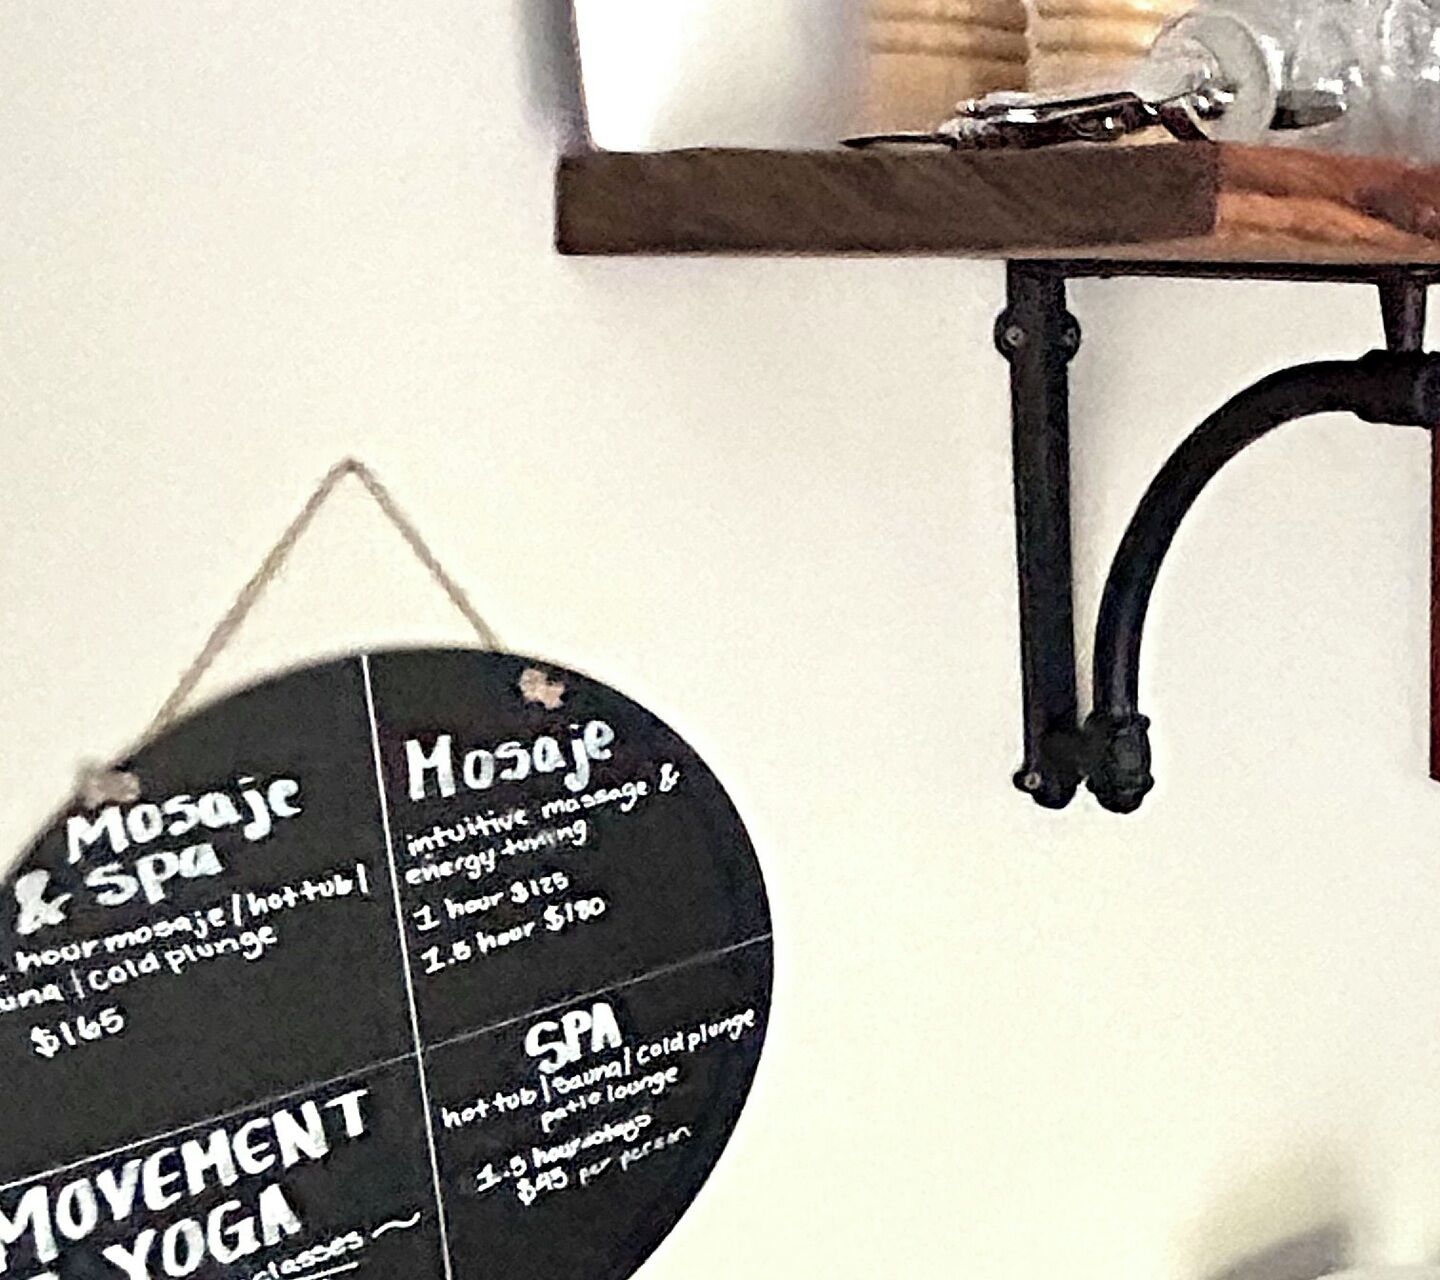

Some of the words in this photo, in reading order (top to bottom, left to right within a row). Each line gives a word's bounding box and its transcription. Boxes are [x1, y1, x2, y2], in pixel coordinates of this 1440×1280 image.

[405, 720, 615, 801] Mosaje
[67, 776, 302, 864] Mosaje
[408, 809, 529, 857] intuitive
[542, 781, 648, 819] massage
[658, 763, 680, 792] &
[404, 848, 497, 885] energy
[15, 869, 73, 935] &
[413, 904, 440, 931] 1
[444, 891, 504, 920] hour
[510, 871, 569, 904] $125
[15, 937, 98, 973] hour
[164, 925, 278, 975] plunge
[476, 921, 536, 955] hour
[30, 1006, 125, 1058] $165
[524, 1002, 623, 1074] SPA
[688, 1007, 756, 1054] plunge
[608, 1066, 679, 1103] lounge
[0, 1088, 369, 1274] MOVEMENT
